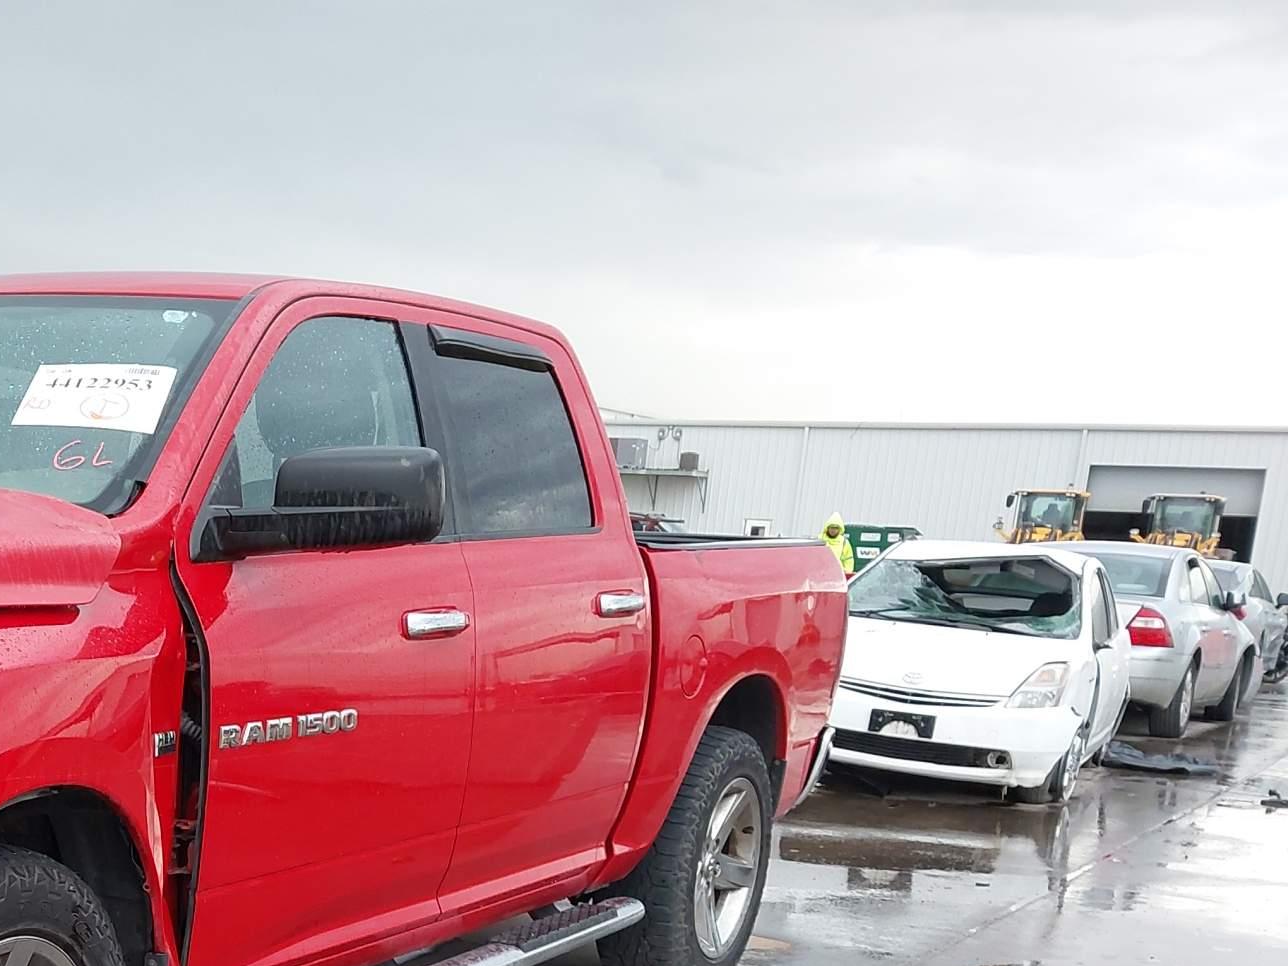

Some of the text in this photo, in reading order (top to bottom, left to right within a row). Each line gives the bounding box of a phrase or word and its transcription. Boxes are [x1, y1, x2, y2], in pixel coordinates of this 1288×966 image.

[45, 376, 153, 391] 44122953
[218, 708, 359, 749] RAM 1500
